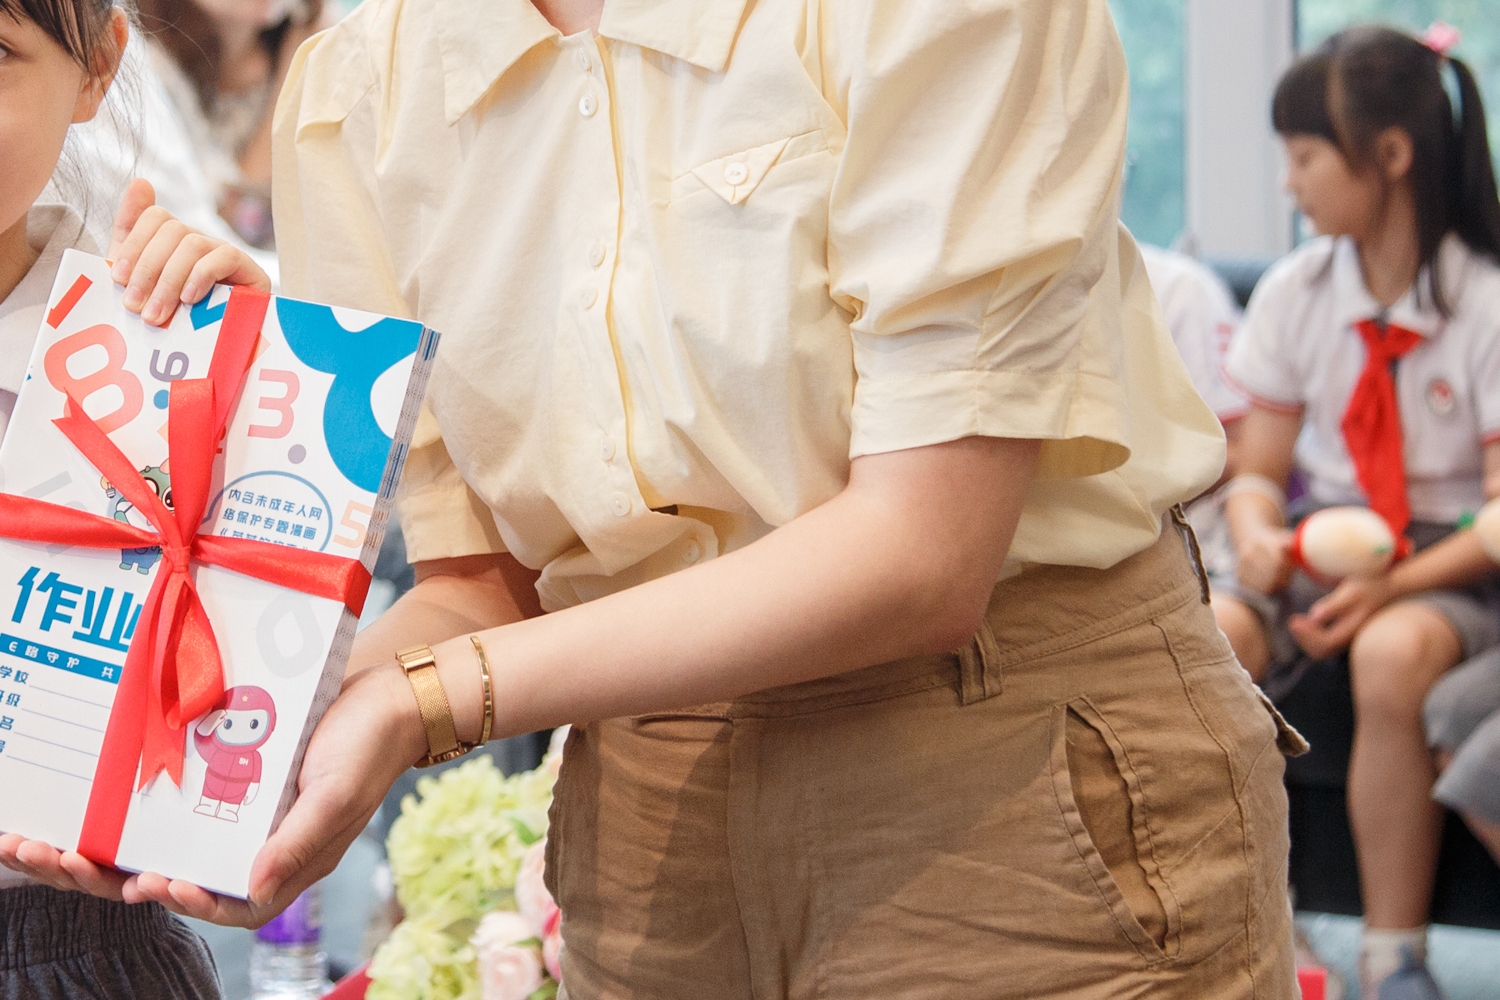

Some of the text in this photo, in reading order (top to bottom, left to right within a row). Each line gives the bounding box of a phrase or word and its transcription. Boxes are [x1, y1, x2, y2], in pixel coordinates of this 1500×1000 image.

[246, 368, 301, 440] 3
[222, 507, 317, 540] 络保护专题漫画
[227, 488, 323, 521] 内含未成年人网
[332, 499, 372, 549] 5
[11, 566, 143, 653] 作业
